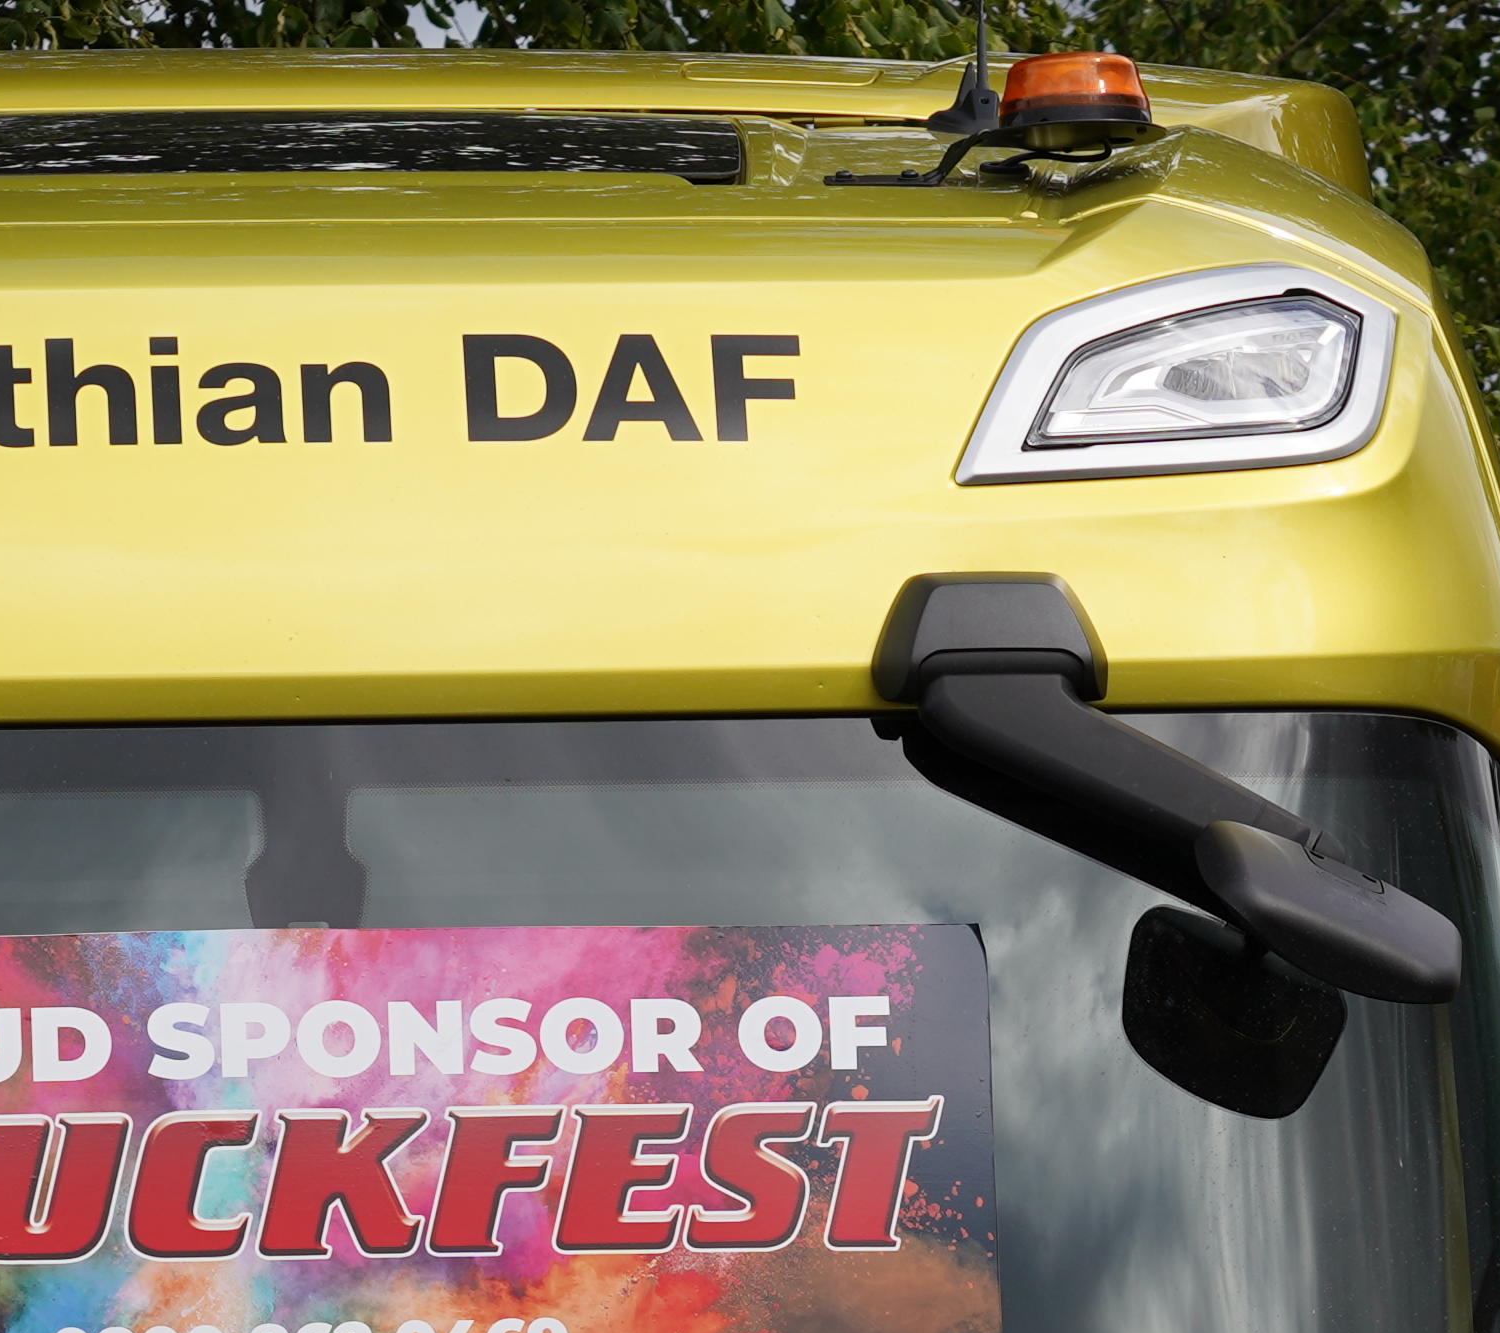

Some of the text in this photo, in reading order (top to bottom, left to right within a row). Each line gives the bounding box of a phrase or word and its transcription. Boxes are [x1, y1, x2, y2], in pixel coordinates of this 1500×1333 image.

[461, 333, 800, 442] DAF
[148, 997, 704, 1080] SPONSOR
[737, 995, 891, 1071] OF
